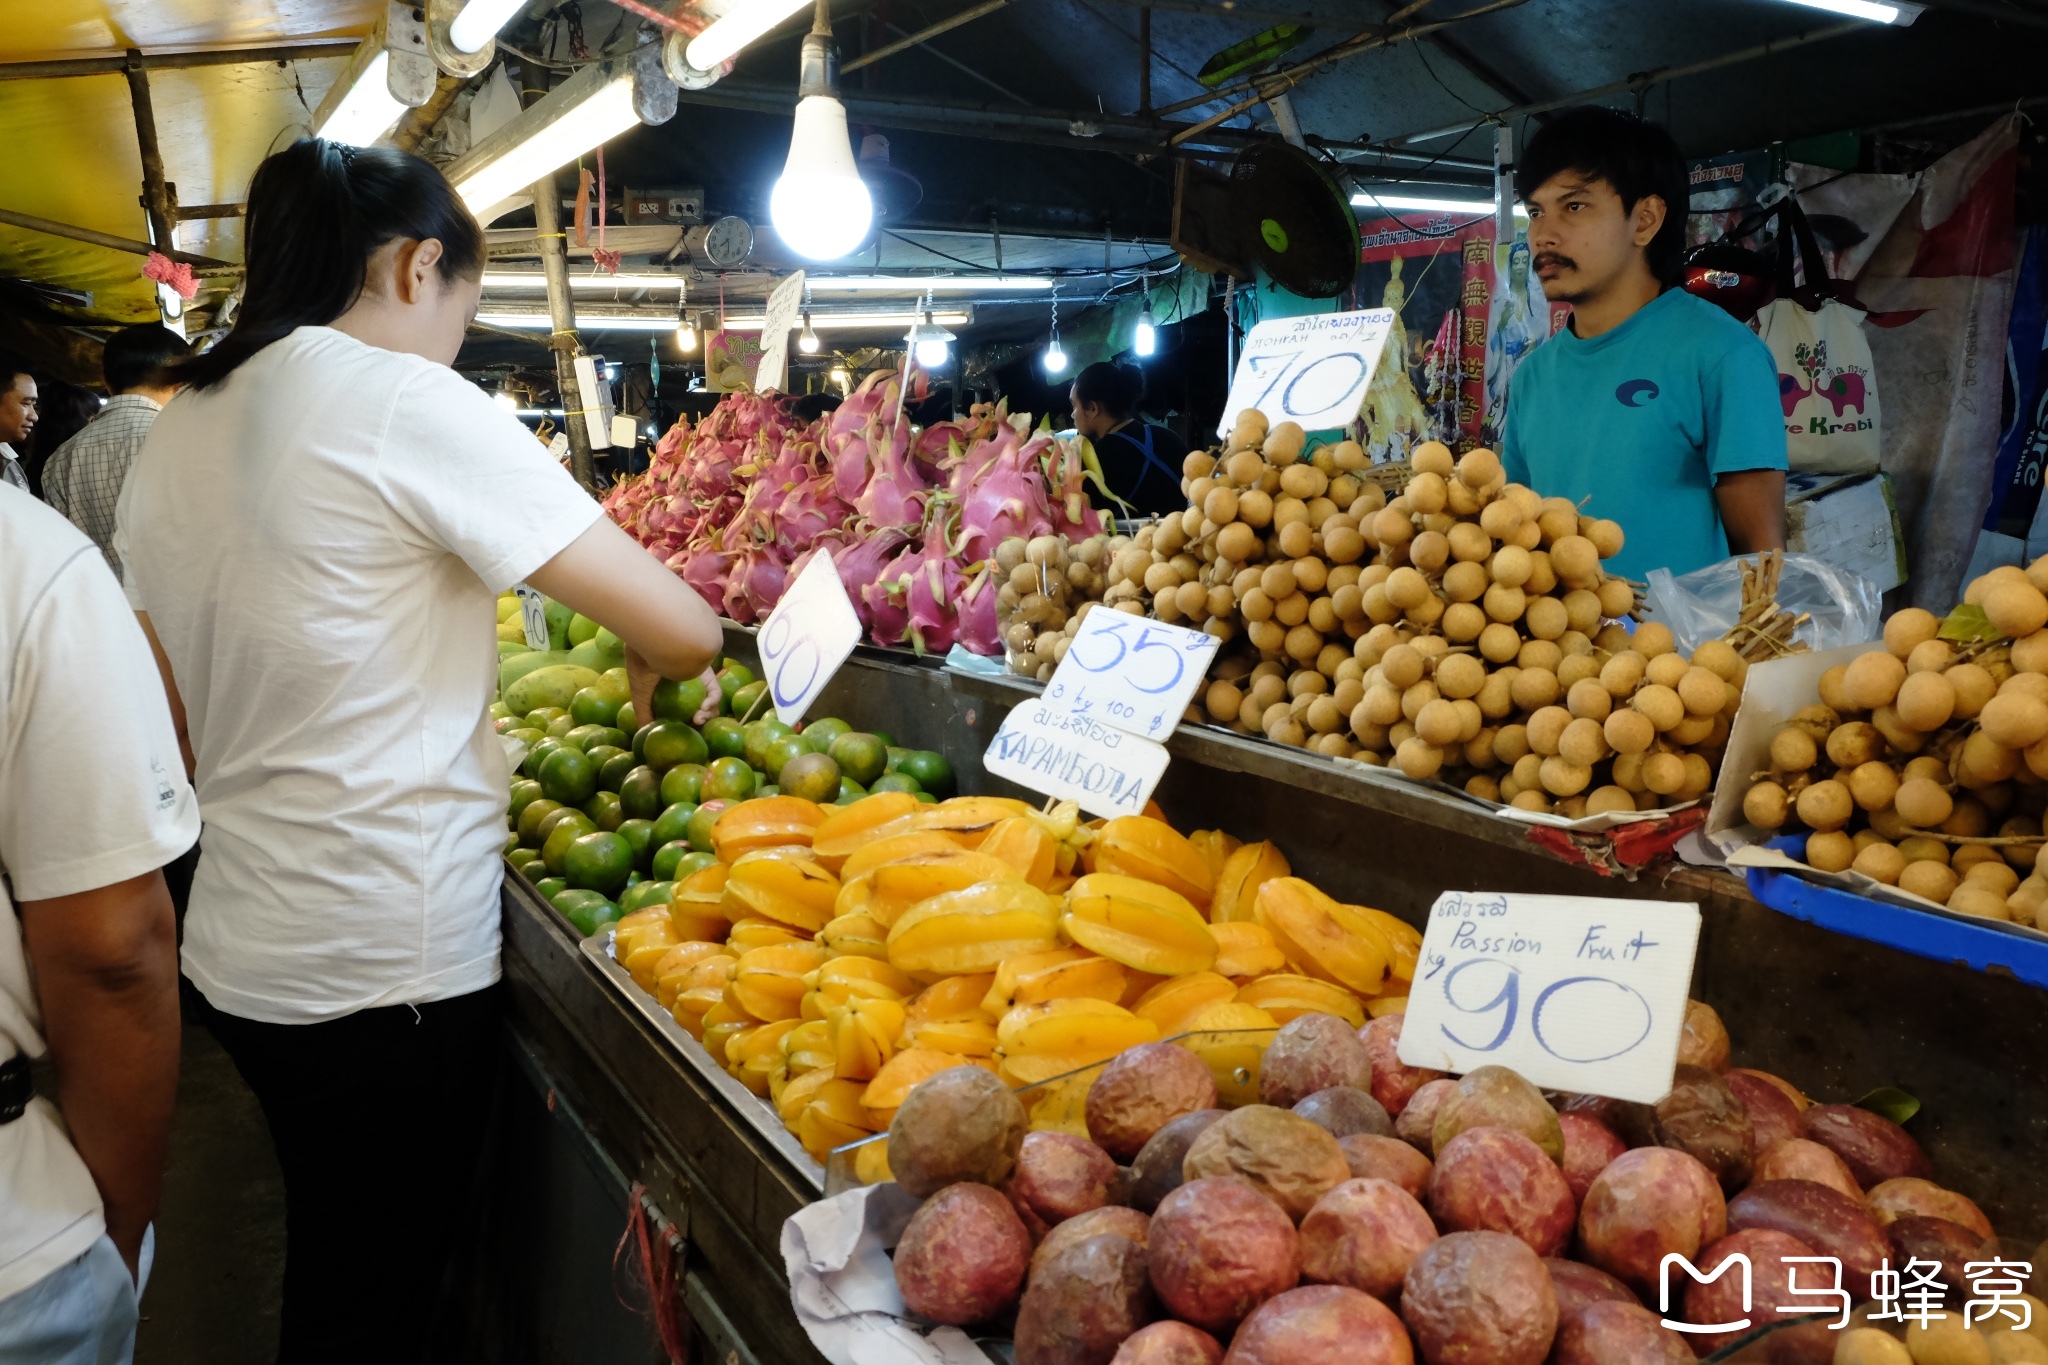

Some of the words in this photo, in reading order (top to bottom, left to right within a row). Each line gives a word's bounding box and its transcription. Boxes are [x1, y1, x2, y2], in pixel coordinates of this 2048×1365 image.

[1249, 350, 1368, 417] 70
[1810, 417, 1873, 435] Krabi
[2024, 429, 2036, 445] TO
[2012, 448, 2029, 486] SHARE
[525, 604, 546, 645] 40
[764, 599, 821, 708] 60
[1070, 612, 1184, 694] 35
[1187, 630, 1217, 651] kg
[1051, 683, 1064, 698] 3
[1107, 700, 1135, 719] 100
[986, 723, 1145, 808] КАРАМБОЛА
[1450, 920, 1542, 955] Passion
[1576, 925, 1660, 961] Fruit
[1425, 948, 1446, 980] kg
[1440, 957, 1652, 1064] 90
